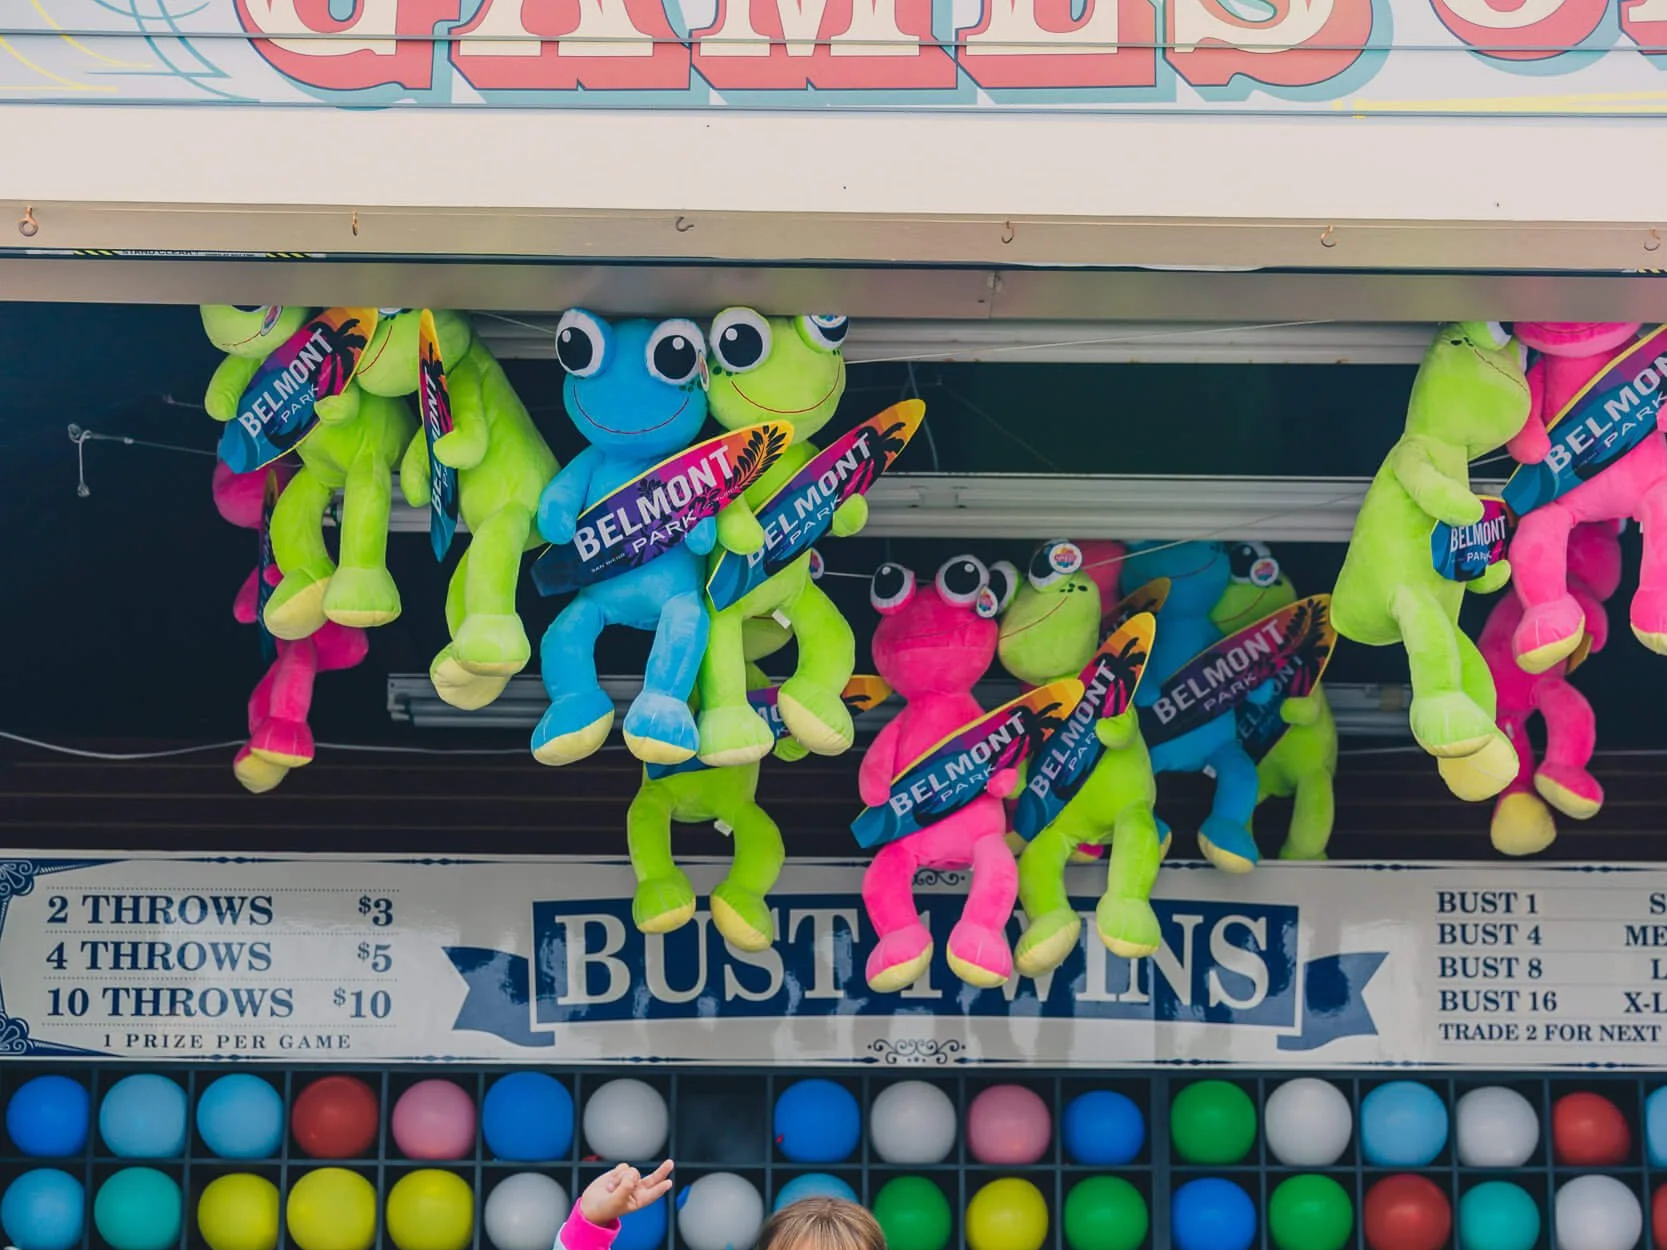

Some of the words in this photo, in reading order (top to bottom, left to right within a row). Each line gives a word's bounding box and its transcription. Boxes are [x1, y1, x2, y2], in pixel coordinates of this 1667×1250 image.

[239, 327, 333, 438] BELMONT
[281, 383, 319, 423] PARK
[573, 445, 733, 562] BELMONT
[790, 494, 842, 545] PARK
[632, 509, 697, 553] PARK
[1450, 515, 1506, 553] BELMONT
[1466, 551, 1492, 563] PARK
[1153, 619, 1285, 725] BELMONT
[1203, 673, 1257, 711] PARK
[1029, 659, 1116, 799] BELMONT
[889, 711, 1025, 817] BELMONT
[940, 763, 996, 802] PARK
[46, 895, 69, 925] 2
[81, 895, 274, 926] THROWS
[357, 895, 394, 928] $3
[1436, 891, 1518, 914] BUST
[1527, 893, 1539, 914] 1
[1437, 923, 1519, 946] BUST
[1526, 925, 1543, 946] 4
[45, 941, 68, 971] 4
[80, 941, 273, 972] THROWS
[356, 941, 393, 973] $5
[554, 908, 860, 1006] BUST
[1438, 956, 1520, 979] BUST
[1527, 957, 1544, 979] 8
[47, 987, 89, 1017] 10
[101, 987, 294, 1018] THROWS
[332, 987, 392, 1019] $10
[1438, 989, 1520, 1012] BUST
[1528, 991, 1558, 1012] 16
[103, 1033, 112, 1048] 1
[126, 1033, 204, 1049] PRIZE
[217, 1034, 267, 1049] PER
[279, 1034, 352, 1050] GAME
[1438, 1023, 1519, 1041] TRADE
[1525, 1024, 1538, 1041] 2
[1544, 1024, 1592, 1042] FOR
[1599, 1024, 1662, 1042] NEXT
